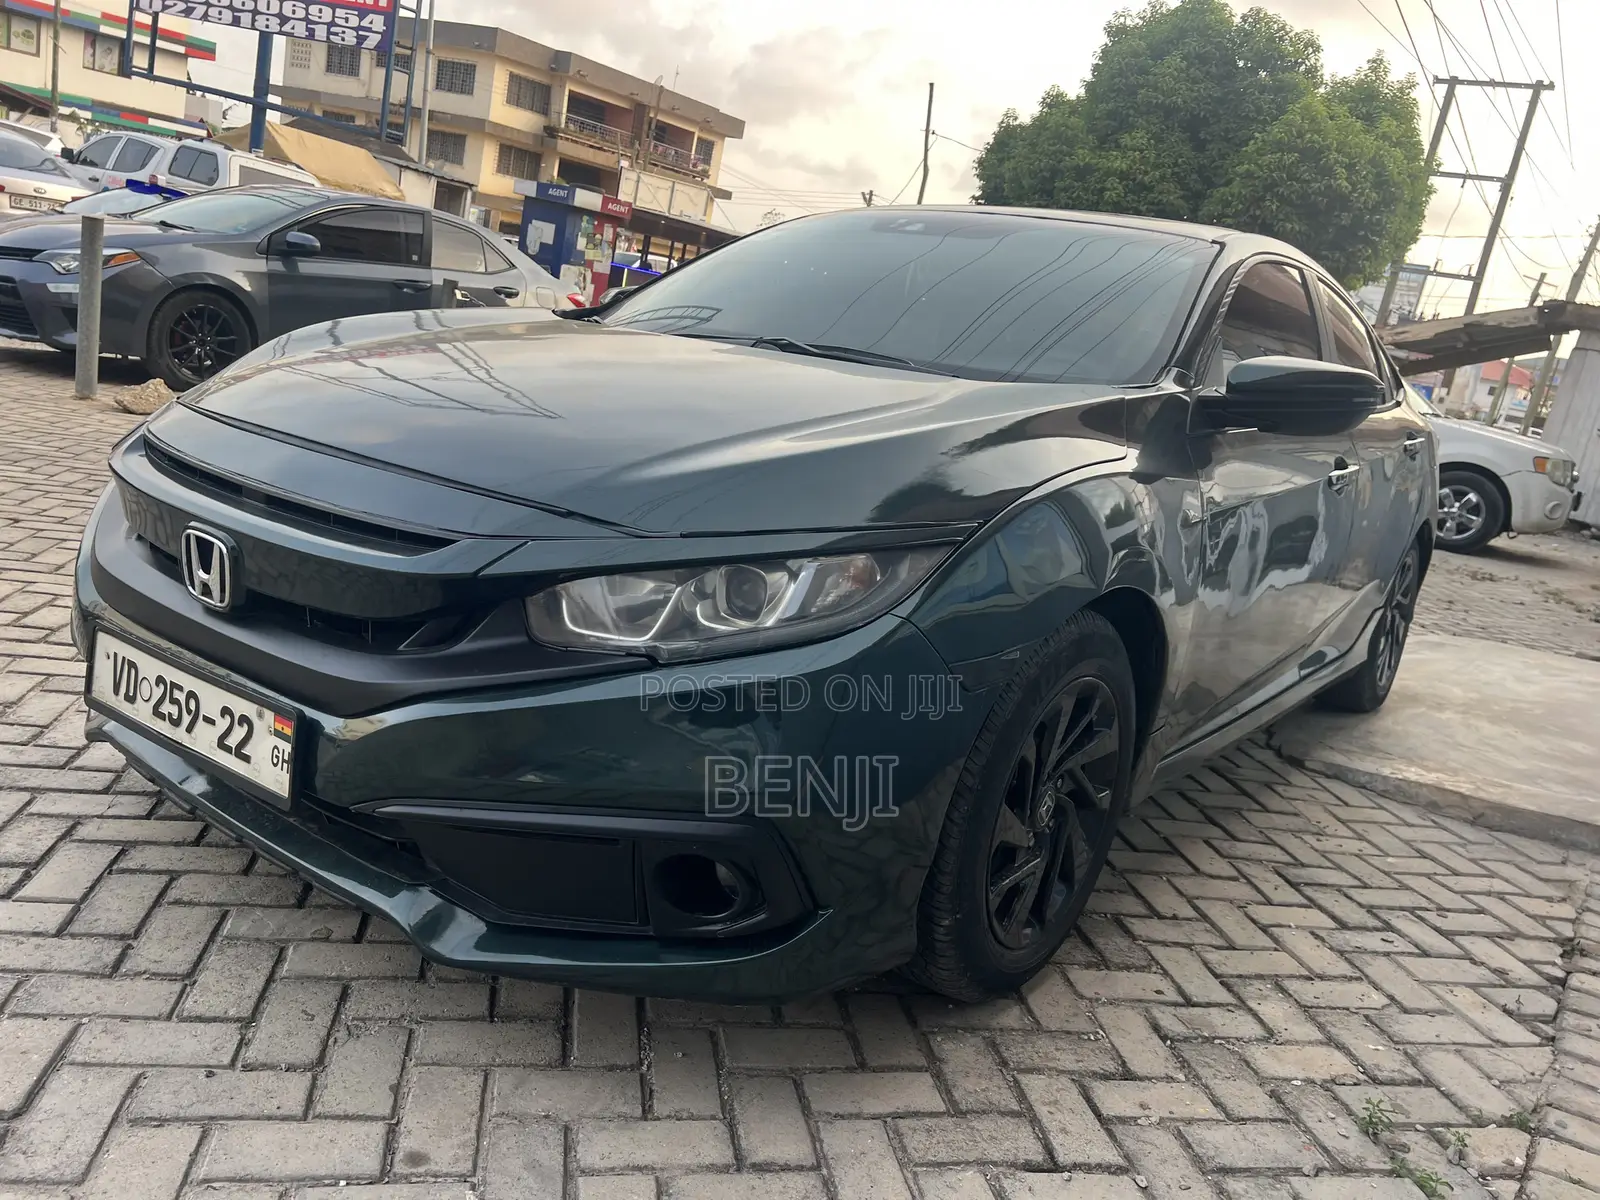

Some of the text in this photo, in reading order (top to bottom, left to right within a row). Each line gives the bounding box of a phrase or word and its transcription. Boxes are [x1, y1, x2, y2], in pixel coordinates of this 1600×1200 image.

[547, 187, 569, 198] AGENT
[13, 197, 24, 206] GE
[607, 202, 629, 214] AGENT
[151, 674, 255, 765] 259-22
[270, 743, 291, 775] GH
